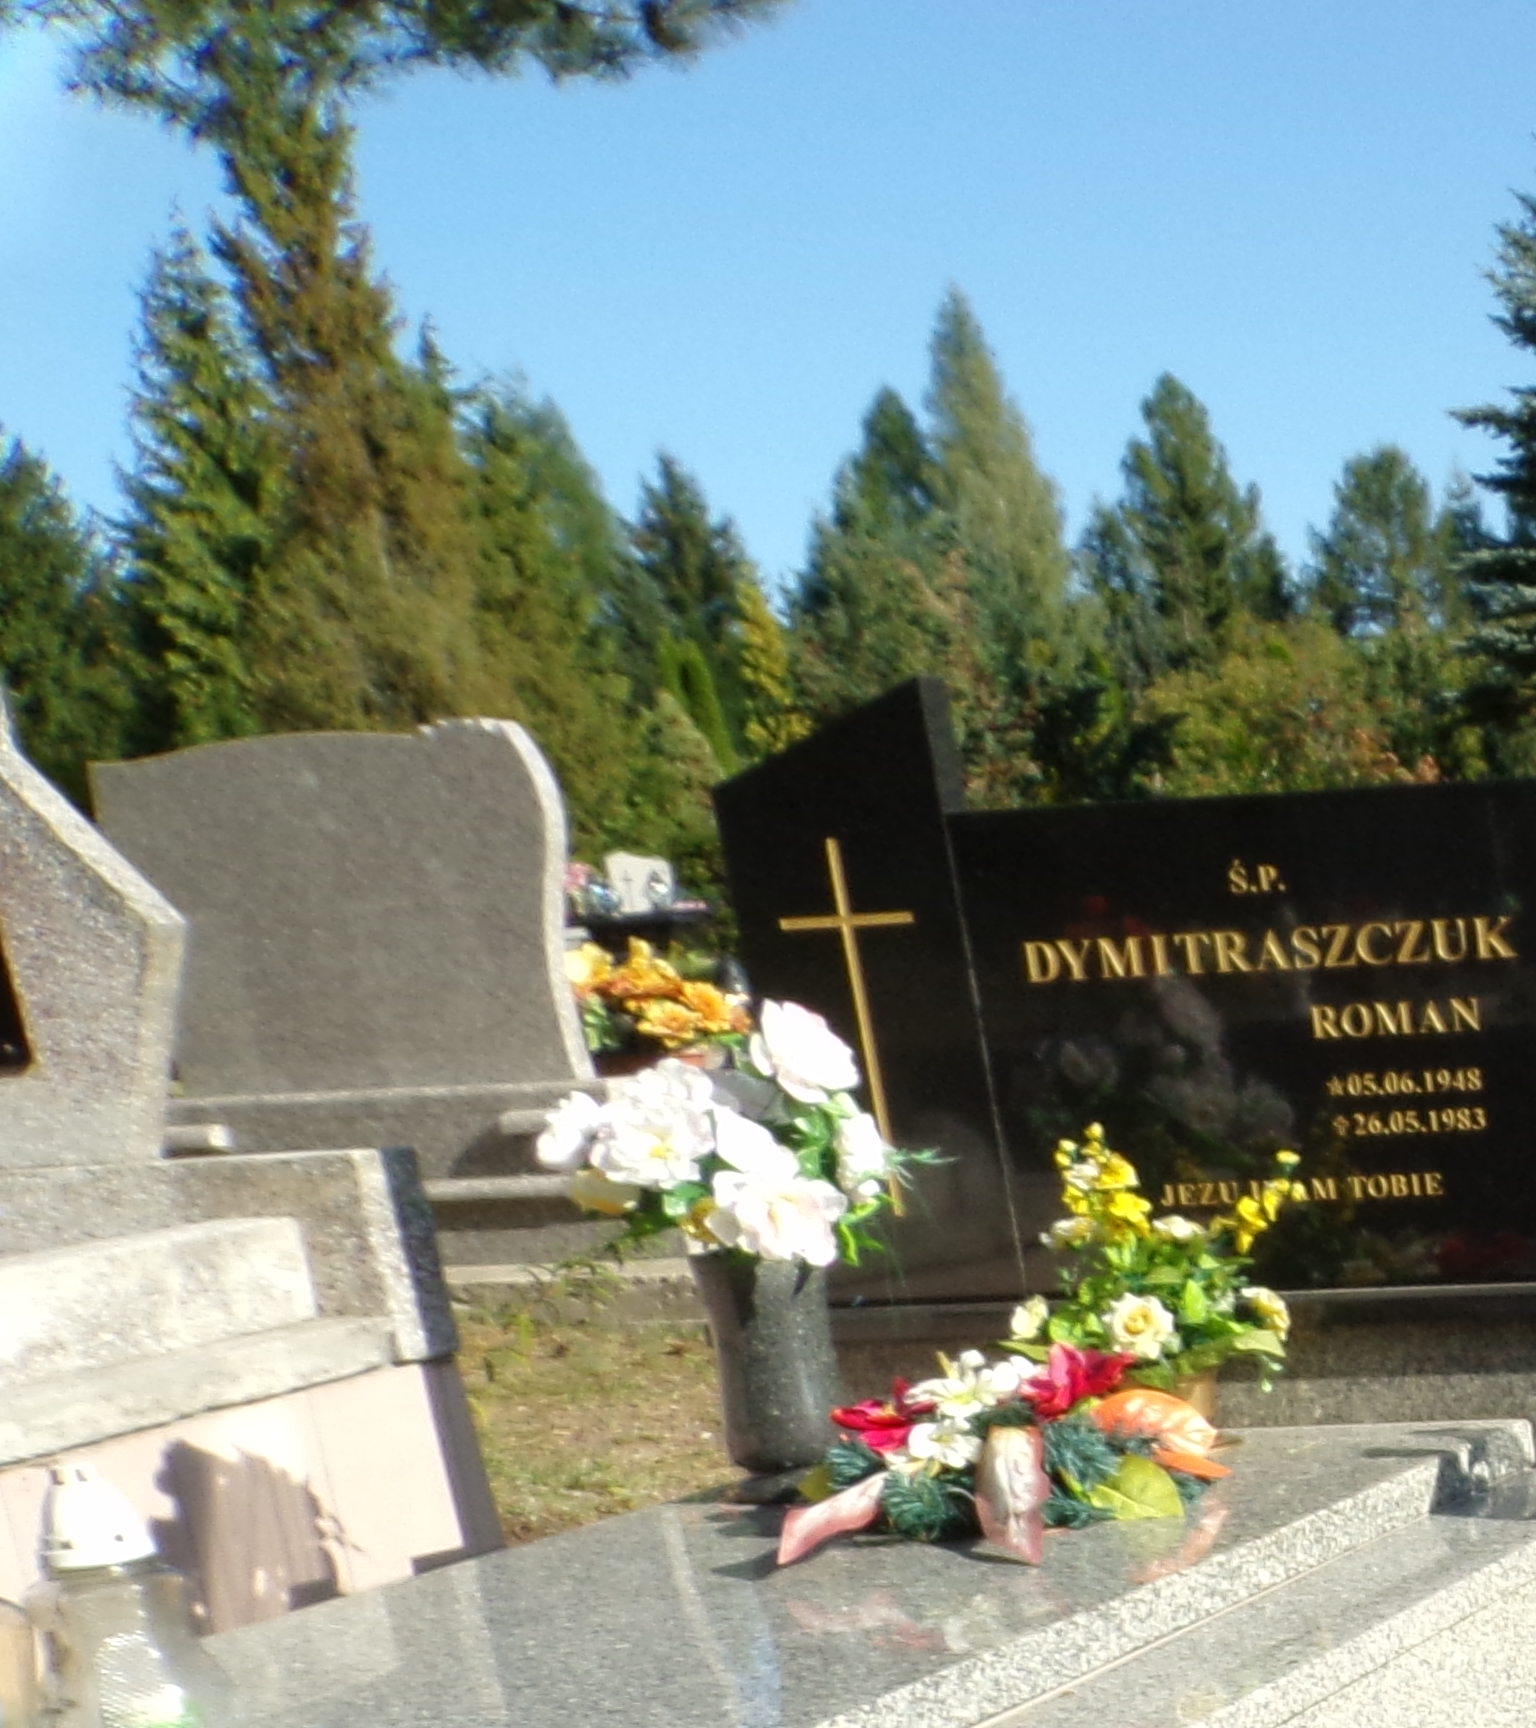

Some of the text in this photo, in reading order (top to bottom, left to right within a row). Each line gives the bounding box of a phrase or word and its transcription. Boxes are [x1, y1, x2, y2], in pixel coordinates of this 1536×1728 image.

[1226, 858, 1286, 895] Ś.P.
[1022, 915, 1520, 984] DYMITRASZCZUK
[1310, 996, 1482, 1040] ROMAN
[1345, 1067, 1483, 1096] 05.06.1948
[1353, 1107, 1487, 1136] 26.05.1983
[1161, 1181, 1240, 1208] JEZU
[1347, 1172, 1444, 1198] TOBIE
